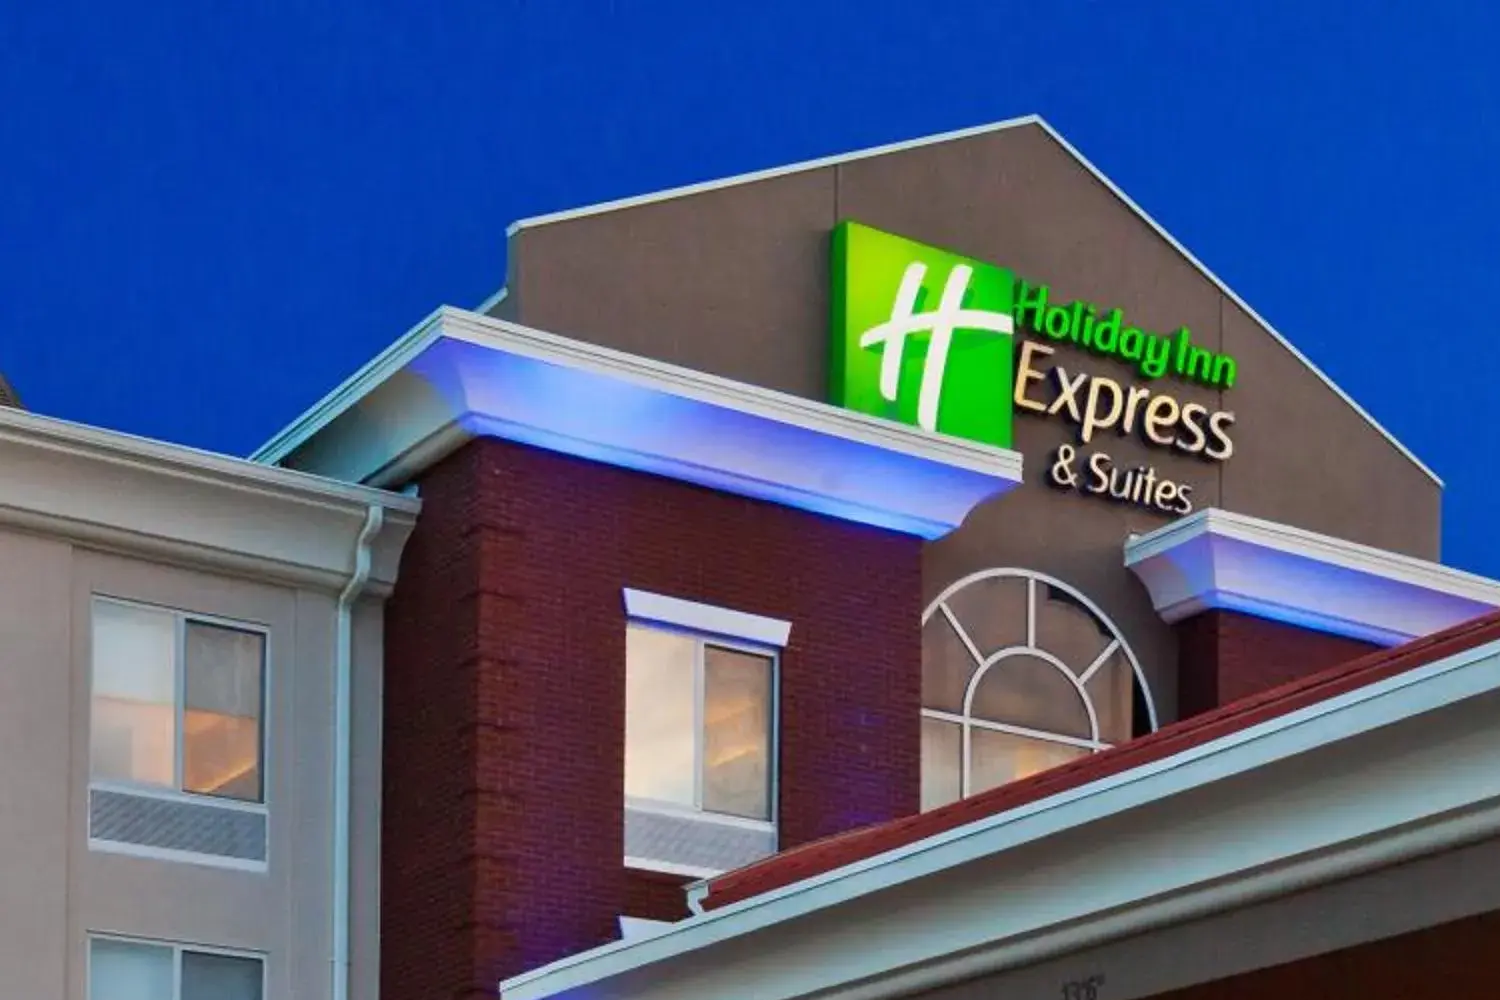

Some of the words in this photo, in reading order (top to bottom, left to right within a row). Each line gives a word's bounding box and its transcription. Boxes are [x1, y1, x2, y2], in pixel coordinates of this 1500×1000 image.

[1013, 280, 1170, 378] Holiday
[1174, 325, 1238, 387] Inn
[1014, 340, 1236, 460] Express
[1051, 444, 1078, 486] &
[1087, 452, 1193, 514] Suites
